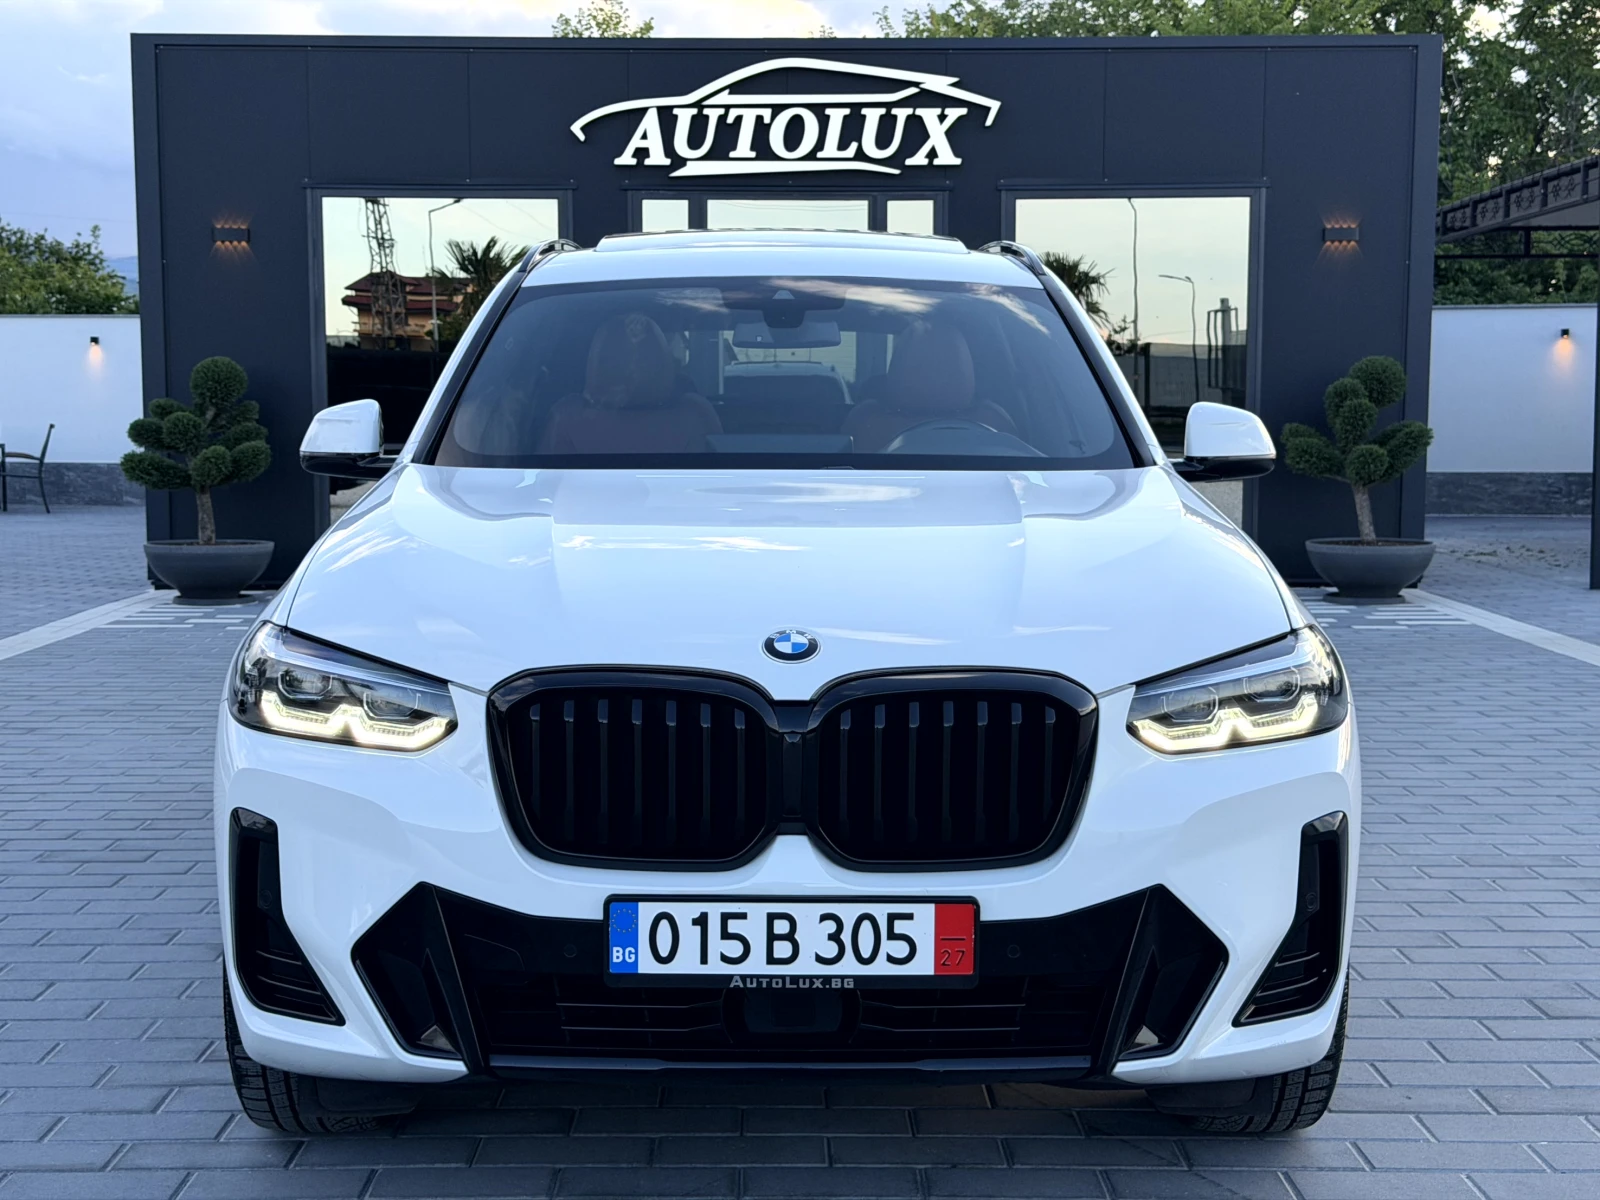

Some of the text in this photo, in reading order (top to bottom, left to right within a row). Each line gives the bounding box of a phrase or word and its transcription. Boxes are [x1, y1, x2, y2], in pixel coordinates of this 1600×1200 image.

[613, 106, 968, 166] AUTOLUX
[612, 946, 636, 963] BG
[940, 948, 967, 967] 27
